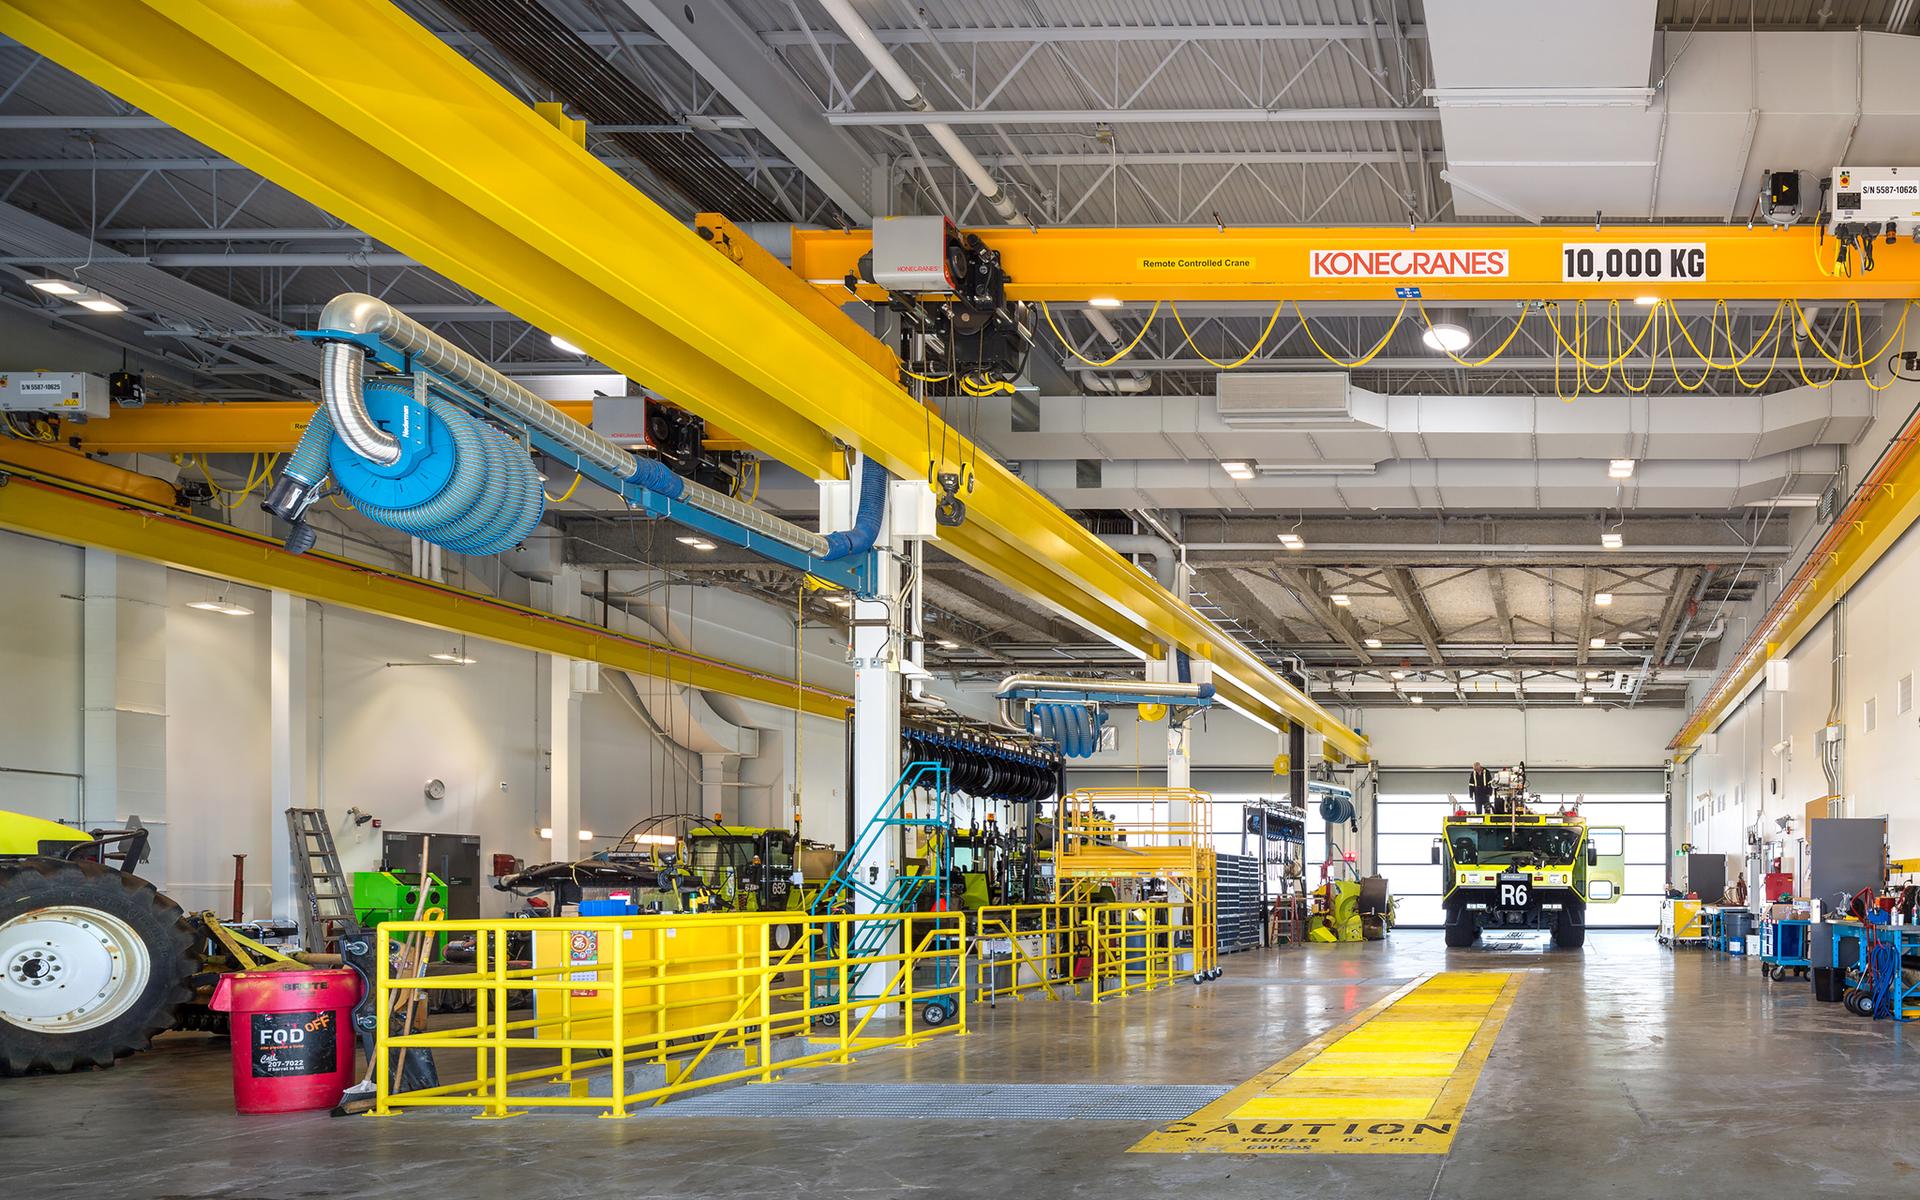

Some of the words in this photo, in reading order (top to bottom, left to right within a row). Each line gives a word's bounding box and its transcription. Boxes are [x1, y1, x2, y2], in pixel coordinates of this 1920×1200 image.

[1862, 186, 1875, 194] S/N
[1876, 186, 1918, 194] 5587-10626
[1143, 259, 1176, 267] Remote
[1178, 259, 1223, 267] Controlled
[1225, 259, 1250, 267] Crane
[1314, 251, 1504, 276] KONECRANES
[1564, 248, 1661, 281] 10,000
[1670, 248, 1704, 278] KG
[772, 882, 786, 895] 652
[1501, 884, 1528, 906] R6
[304, 1014, 330, 1032] OFF
[260, 1029, 304, 1044] FOD
[268, 1059, 304, 1067] 207-7022
[1157, 1122, 1452, 1135] CAUTION
